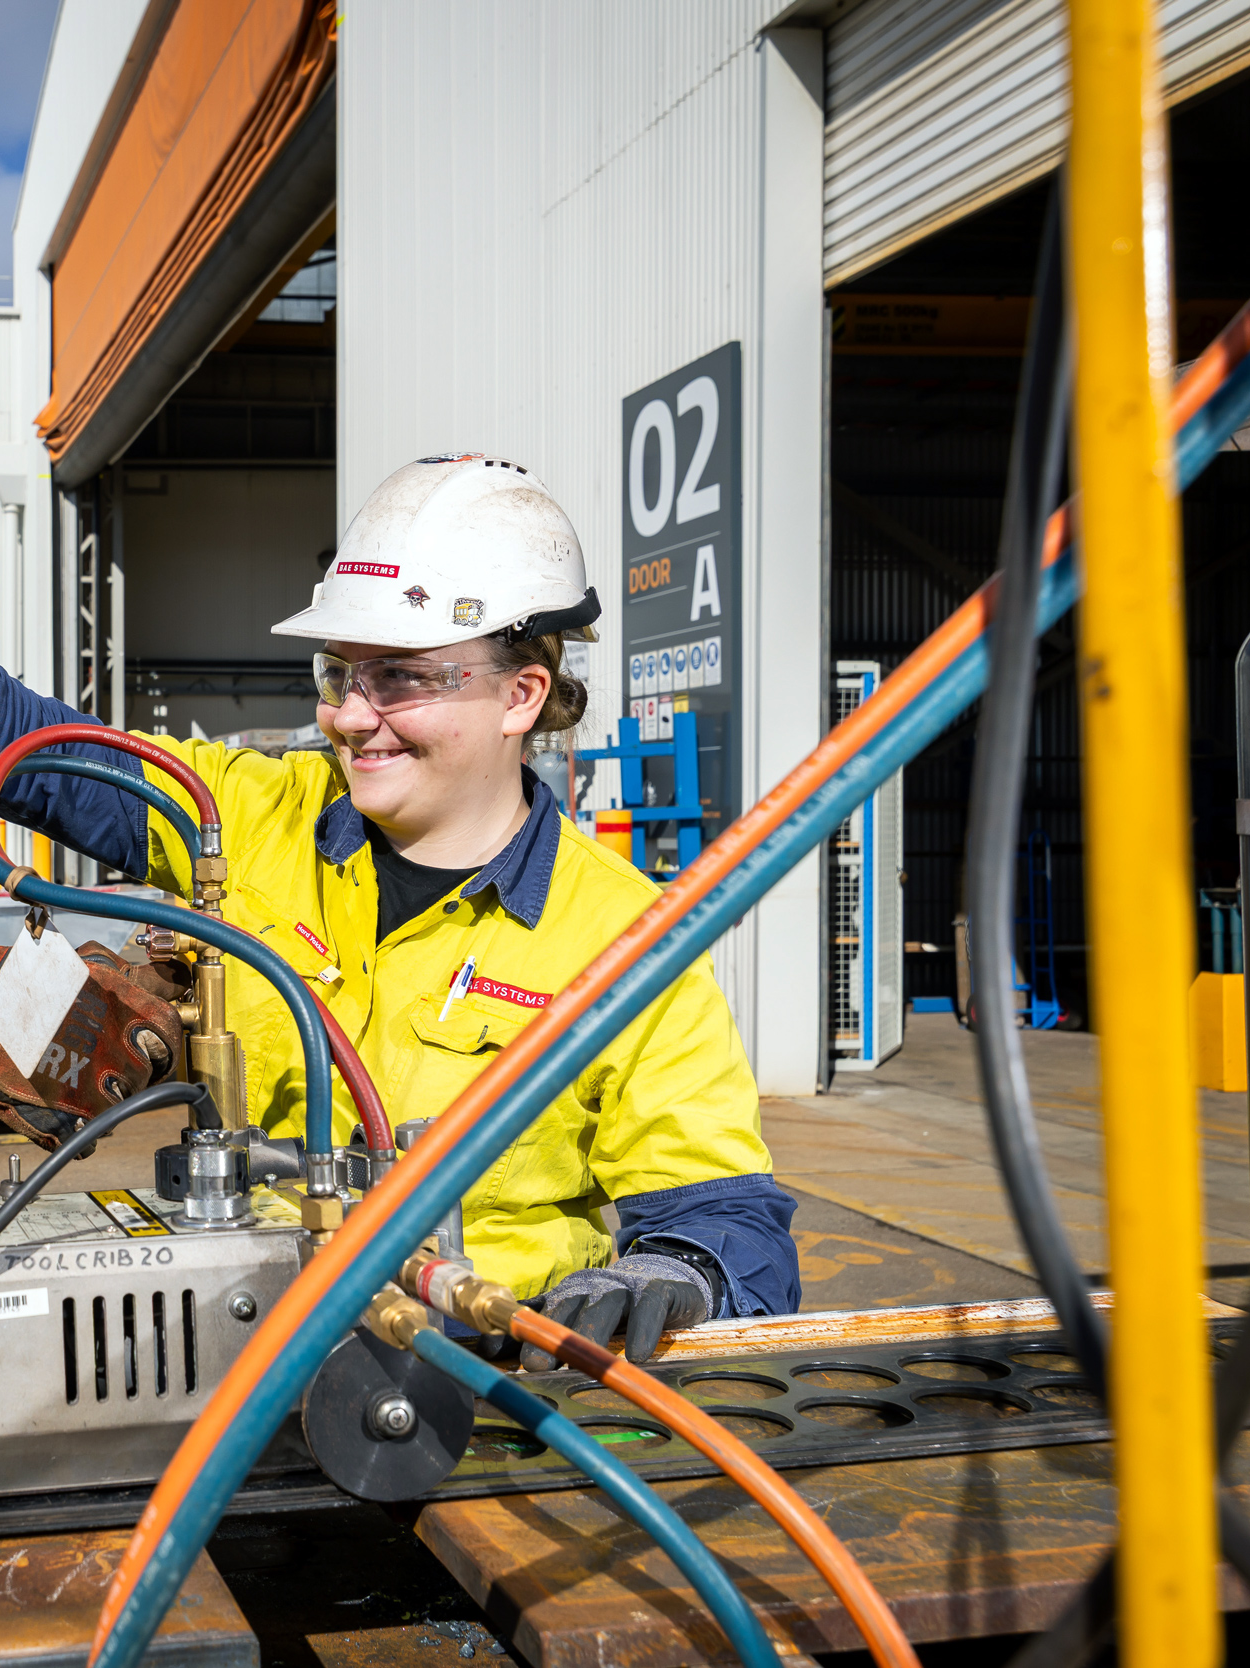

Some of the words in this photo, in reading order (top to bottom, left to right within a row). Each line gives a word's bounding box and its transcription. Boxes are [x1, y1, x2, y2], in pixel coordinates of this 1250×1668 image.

[629, 376, 720, 537] 02
[338, 564, 352, 572] BAE
[353, 564, 396, 575] SYSTEMS
[629, 557, 671, 595] DOOR
[690, 544, 721, 622] A
[296, 924, 311, 938] Hard
[309, 935, 325, 953] Yakka
[482, 982, 545, 1006] SYSTEMS
[36, 1041, 90, 1089] RX
